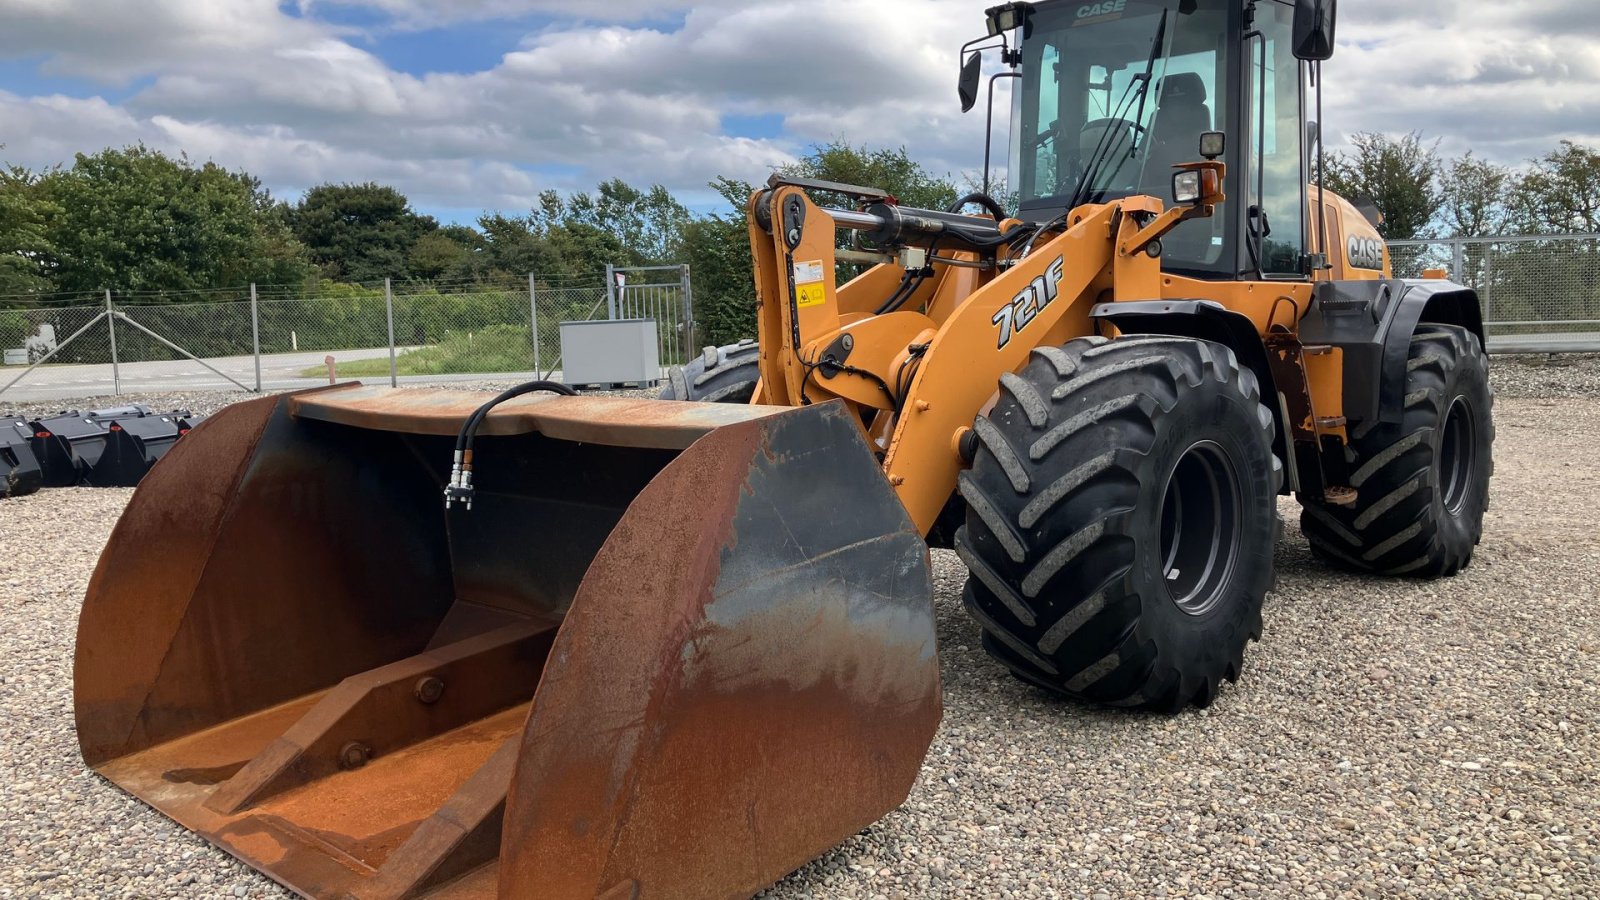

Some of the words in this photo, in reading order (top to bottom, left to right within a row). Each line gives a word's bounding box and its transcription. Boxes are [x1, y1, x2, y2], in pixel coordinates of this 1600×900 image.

[1076, 0, 1127, 18] CASE
[1346, 235, 1383, 268] CASE
[992, 253, 1063, 350] 721F
